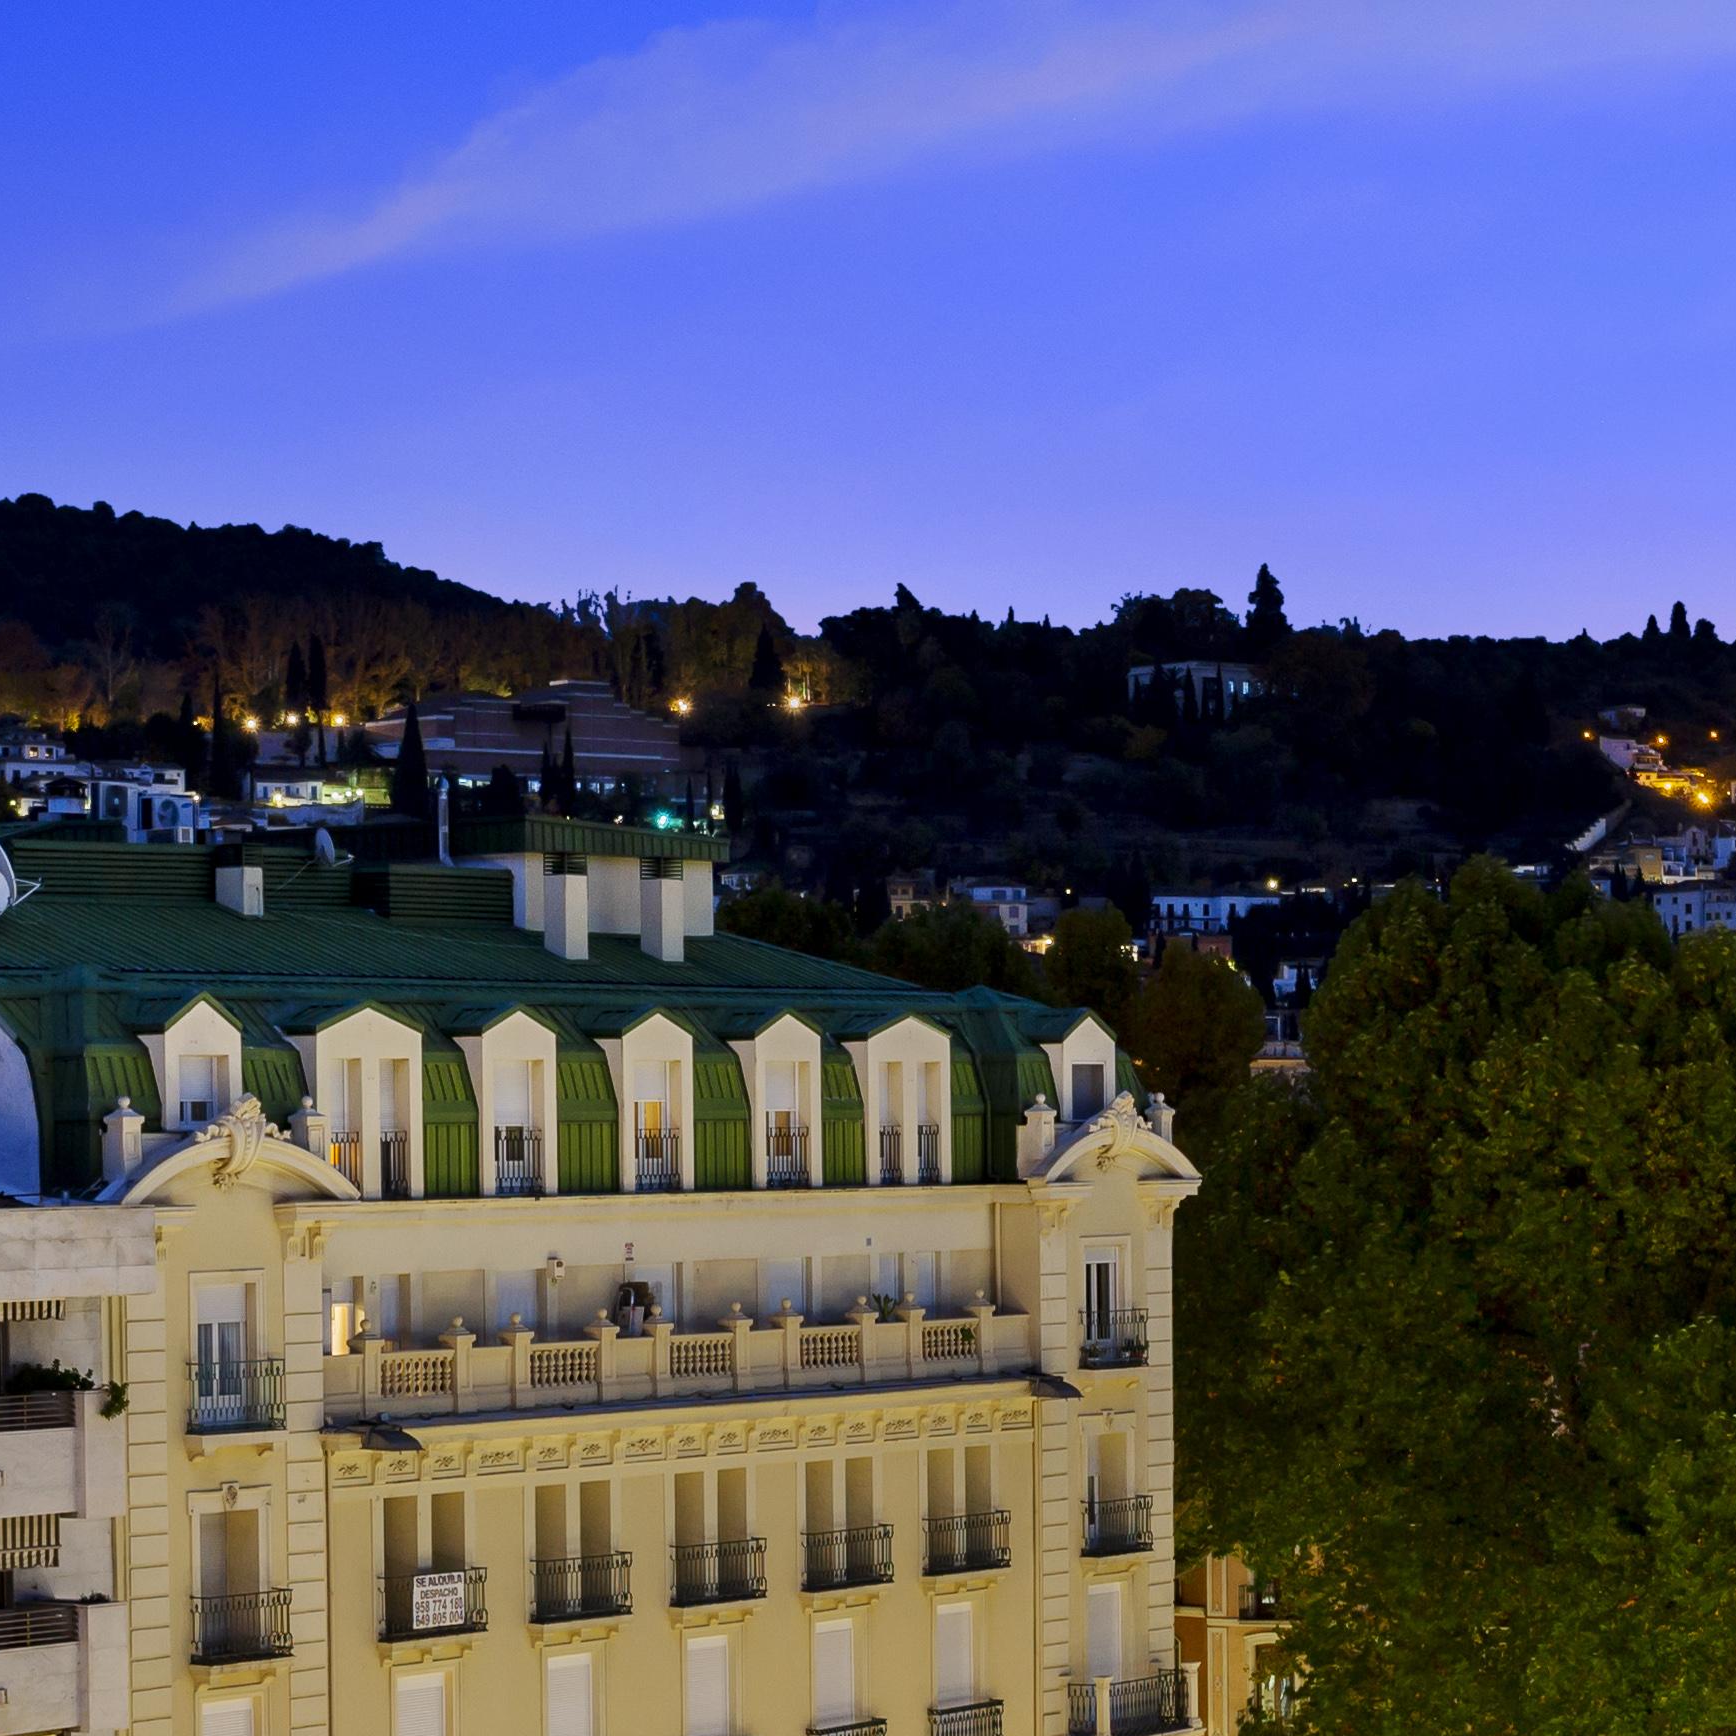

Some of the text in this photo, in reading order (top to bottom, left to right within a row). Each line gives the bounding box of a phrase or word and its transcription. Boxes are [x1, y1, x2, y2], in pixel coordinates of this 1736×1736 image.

[415, 1574, 462, 1588] SE ALQUILA
[420, 1587, 458, 1600] DESPACHO
[415, 1600, 430, 1614] 958
[432, 1599, 447, 1611] 774
